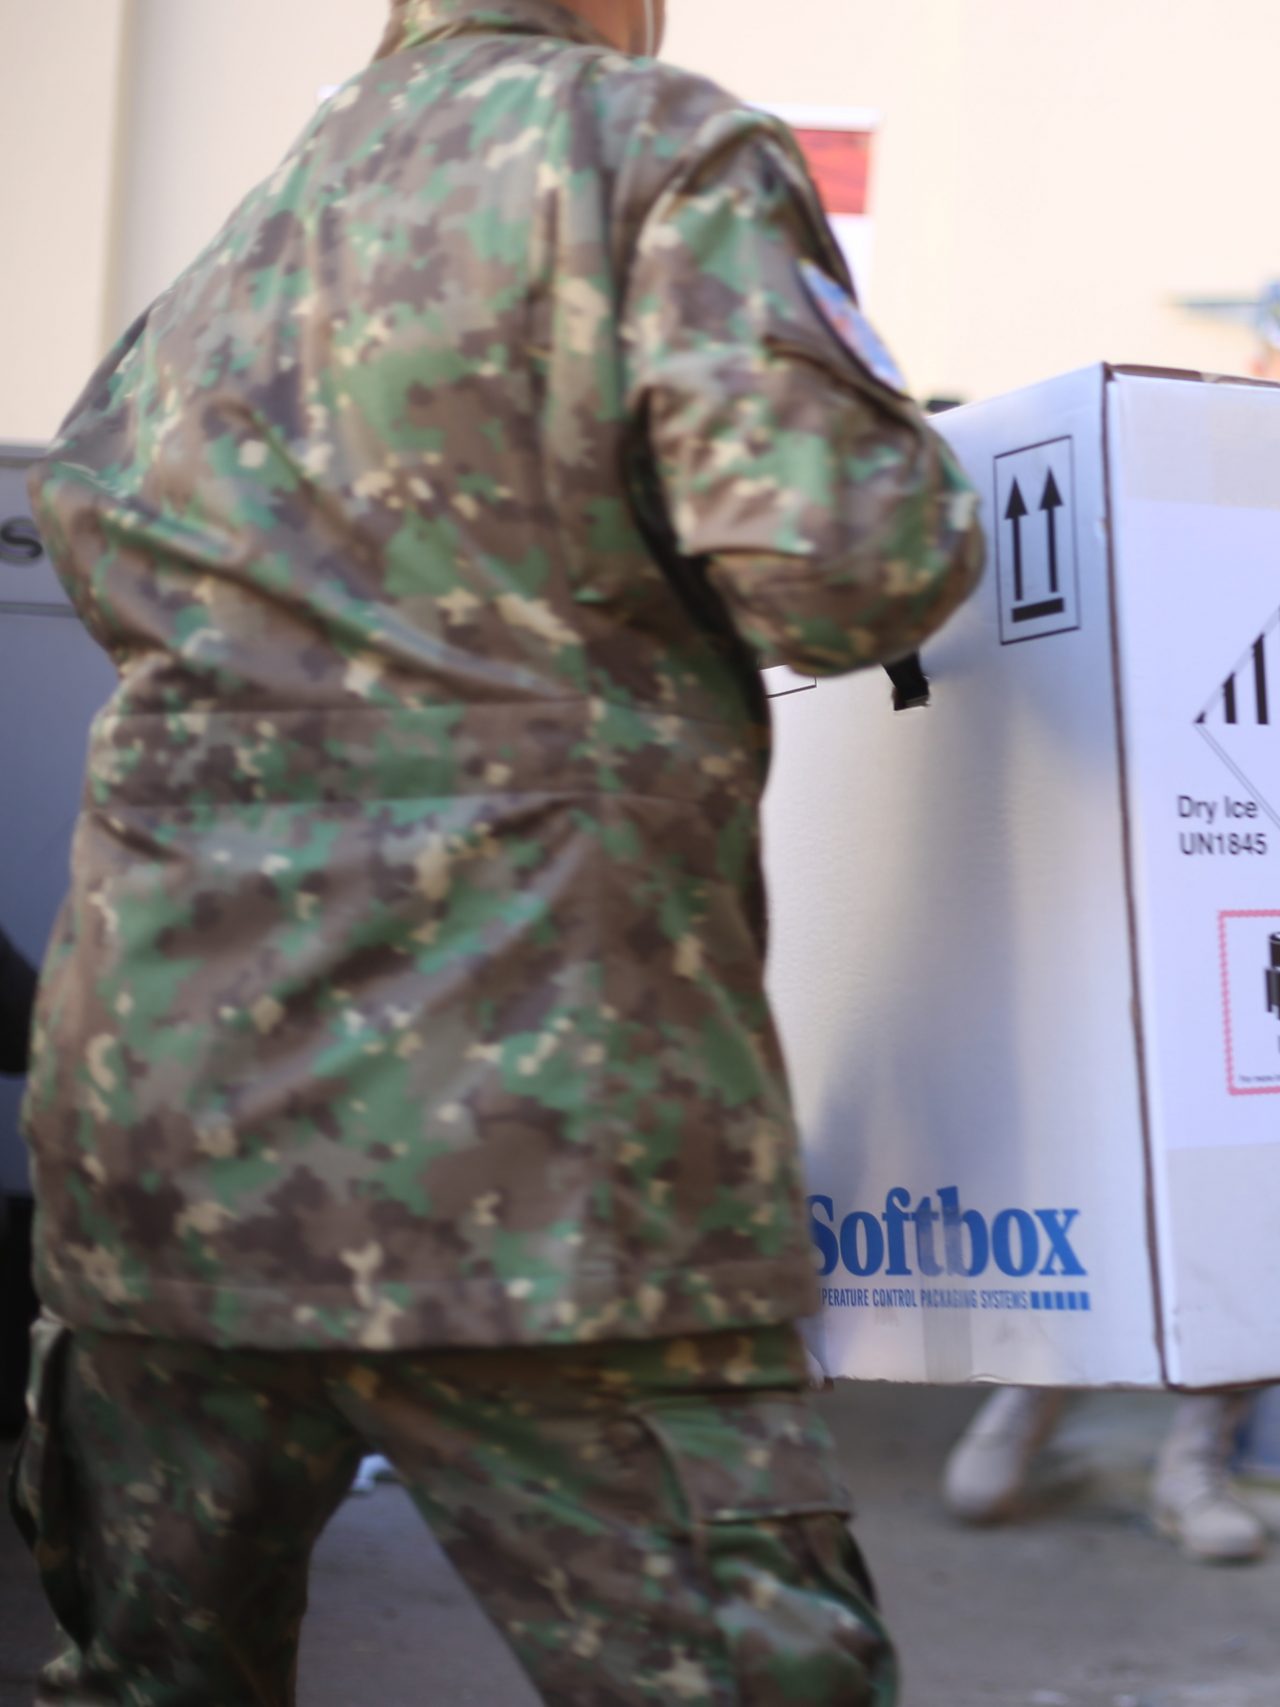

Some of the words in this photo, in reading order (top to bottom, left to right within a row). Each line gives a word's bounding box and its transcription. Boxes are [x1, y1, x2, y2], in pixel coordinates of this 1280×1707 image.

[1177, 795, 1216, 824] Dry
[1225, 795, 1258, 818] Ice
[1179, 832, 1268, 855] UN1845
[807, 1186, 1087, 1277] Softbox
[820, 1288, 870, 1307] PERATURE
[872, 1288, 918, 1308] CONTROL
[921, 1289, 977, 1309] PACKAGING
[980, 1290, 1029, 1309] SYSTEMS
